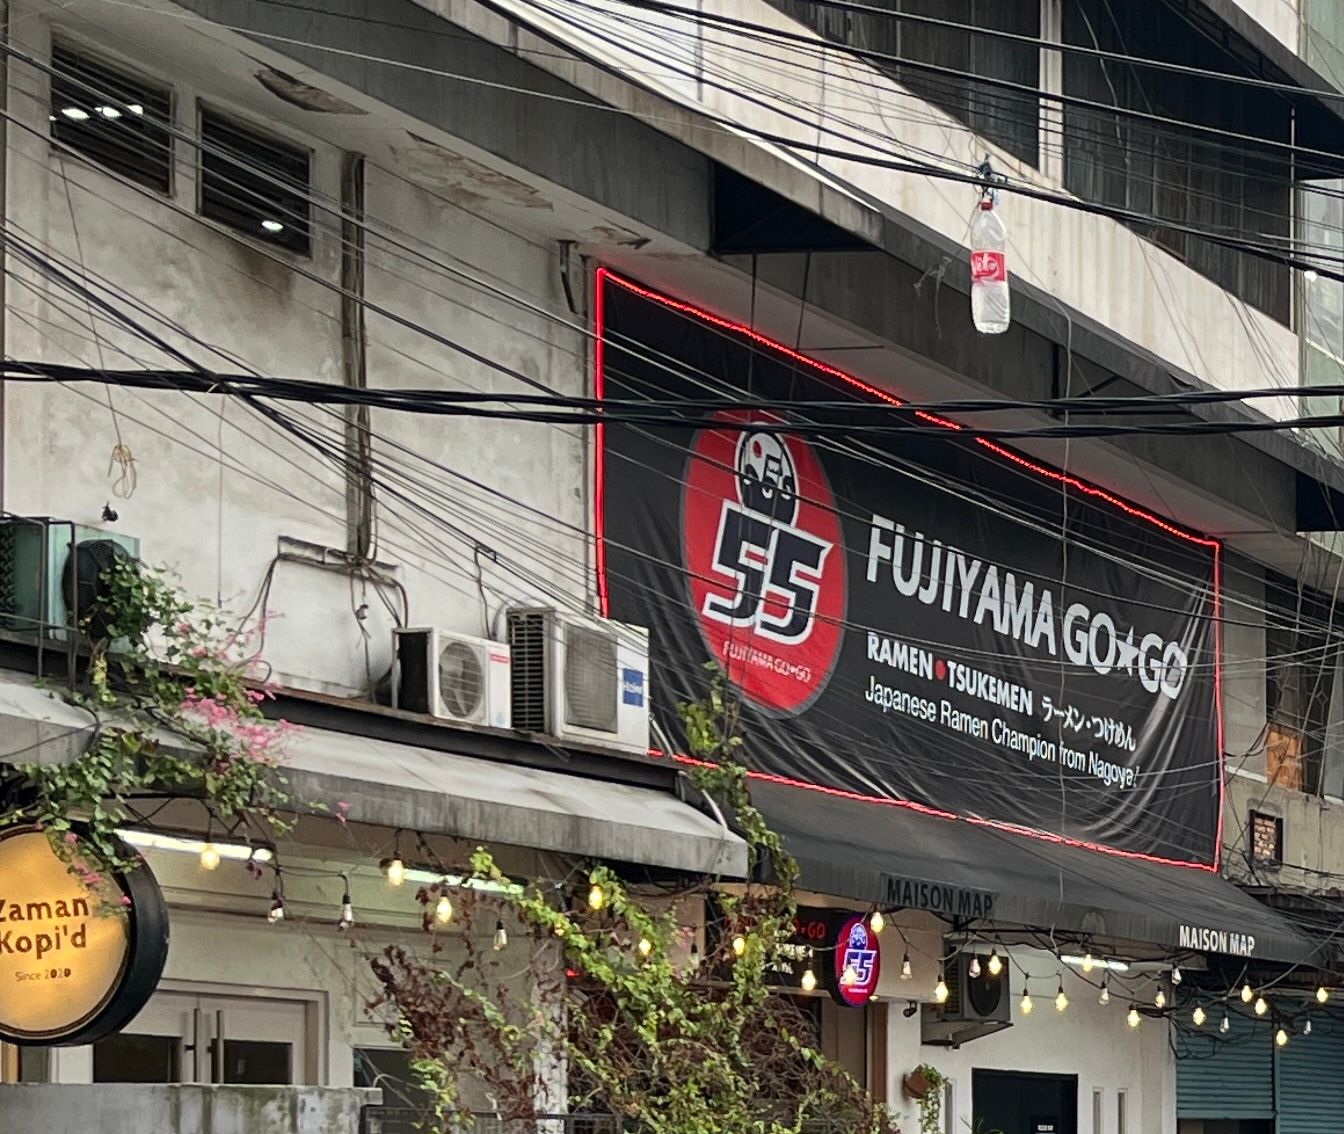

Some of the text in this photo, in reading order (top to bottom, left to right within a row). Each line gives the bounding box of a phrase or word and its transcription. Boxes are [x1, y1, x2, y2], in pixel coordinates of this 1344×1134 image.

[702, 498, 834, 645] 55
[867, 513, 1057, 656] FUJIYAMA
[865, 676, 938, 723] Japanese
[940, 698, 989, 741] Ramen
[991, 717, 1056, 763] Champion
[1059, 741, 1087, 771] from
[887, 876, 994, 921] MAISON MAP
[1179, 925, 1255, 957] MAISON MAP
